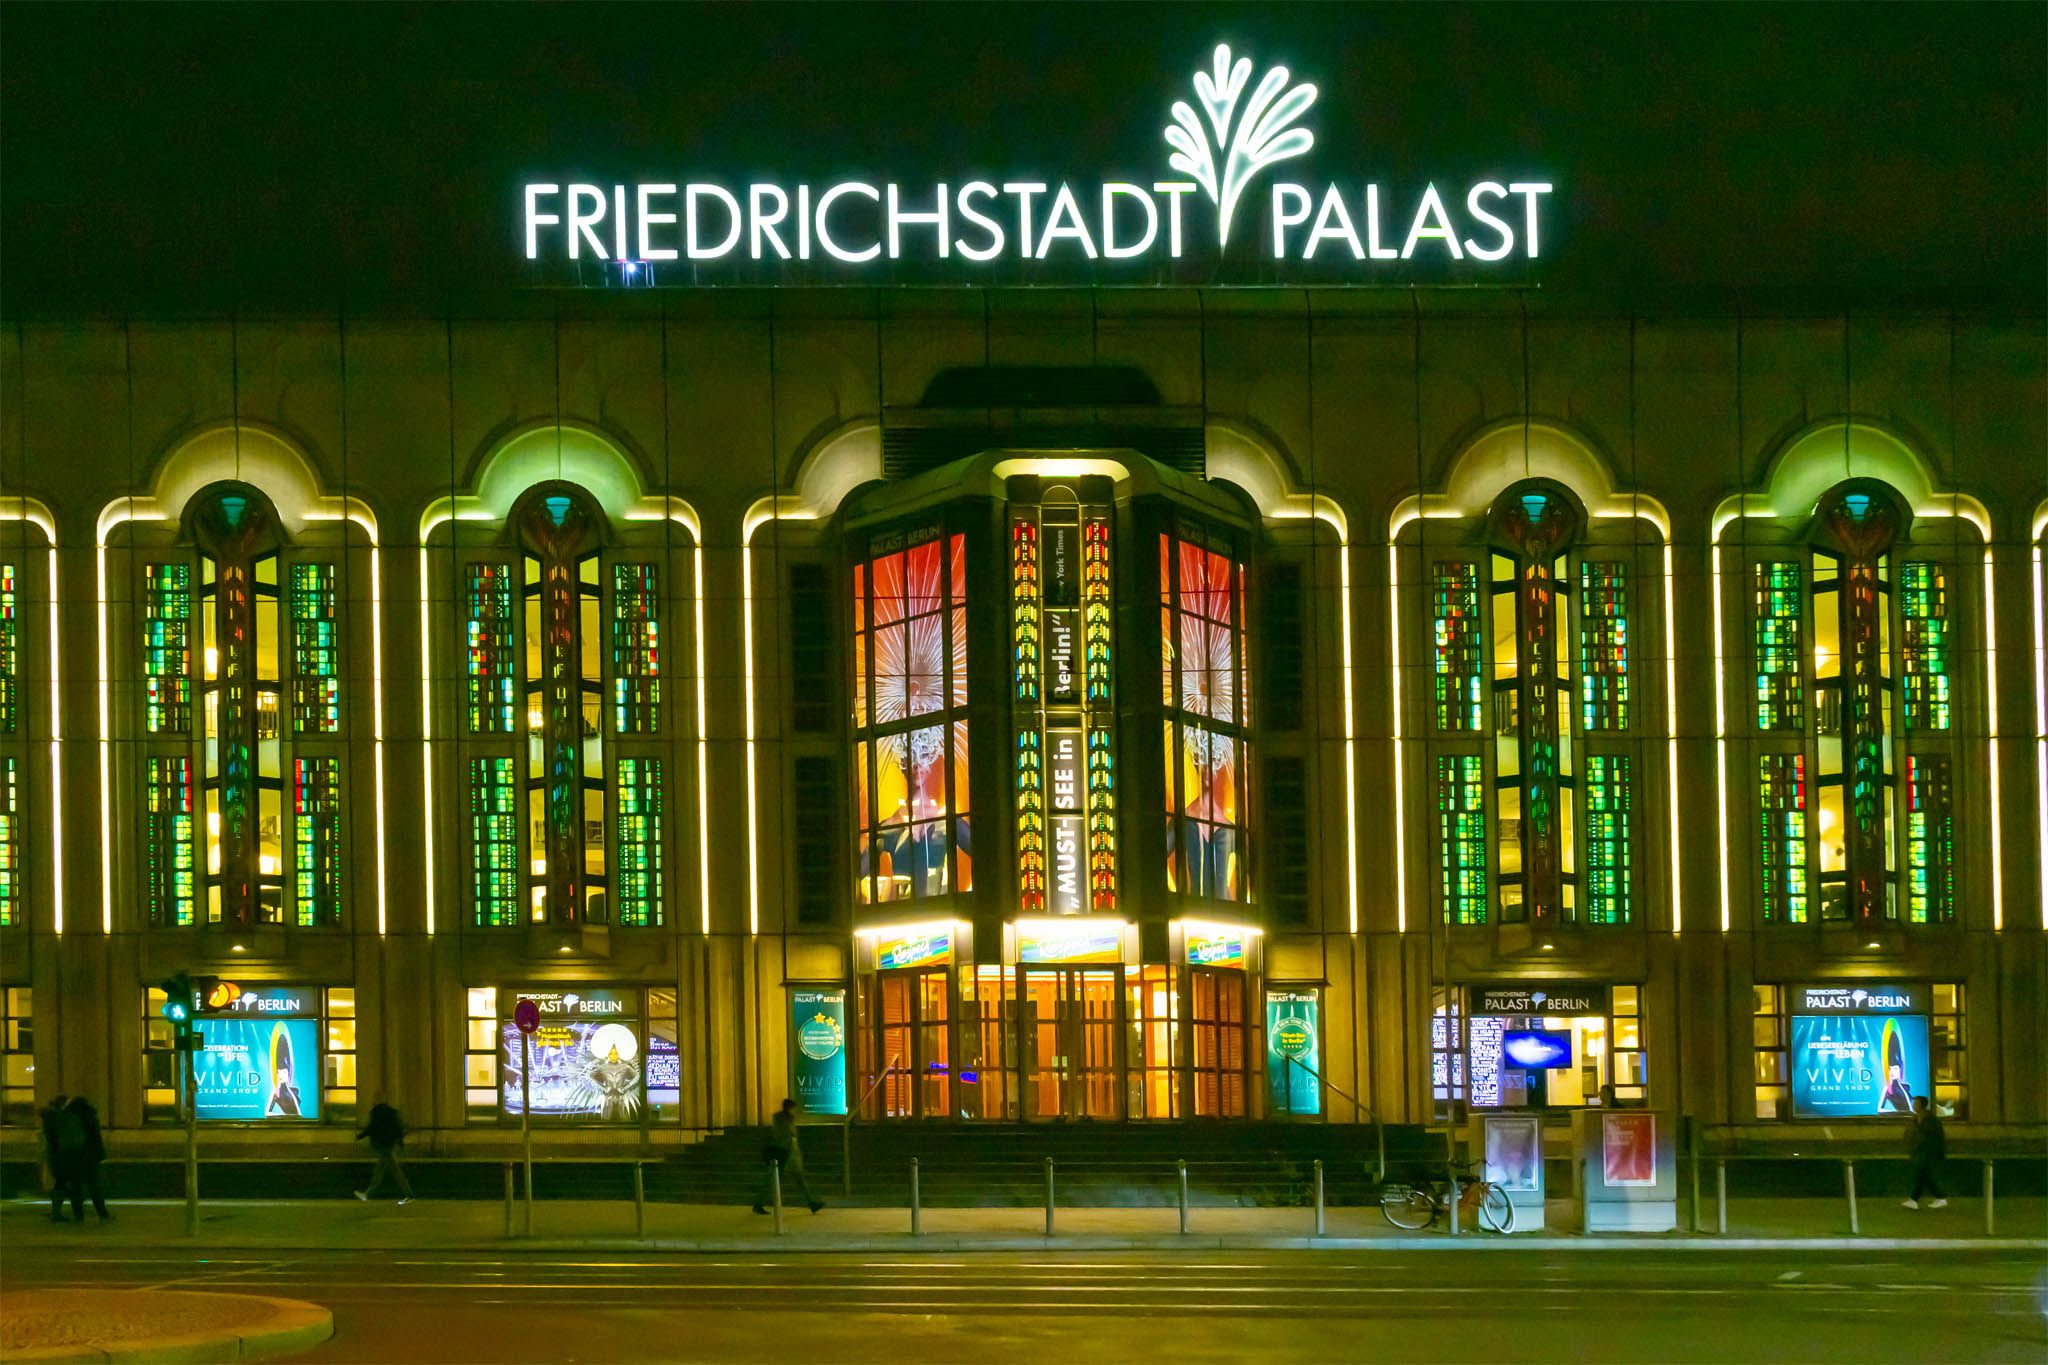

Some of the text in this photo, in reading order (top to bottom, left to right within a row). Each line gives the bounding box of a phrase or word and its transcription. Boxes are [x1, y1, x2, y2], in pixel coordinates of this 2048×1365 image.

[524, 181, 1553, 262] FRIEDRICHSTADT PALAST
[1056, 530, 1065, 558] Times
[1056, 560, 1066, 580] York
[1053, 739, 1073, 760] in
[258, 999, 300, 1011] BERLIN
[579, 1001, 622, 1012] BERLIN
[1485, 999, 1590, 1010] PALAST BERLIN
[1806, 996, 1910, 1008] PALAST BERLIN
[194, 1071, 261, 1086] VIVID
[797, 1075, 842, 1088] VIVID
[1806, 1068, 1873, 1083] VIVID
